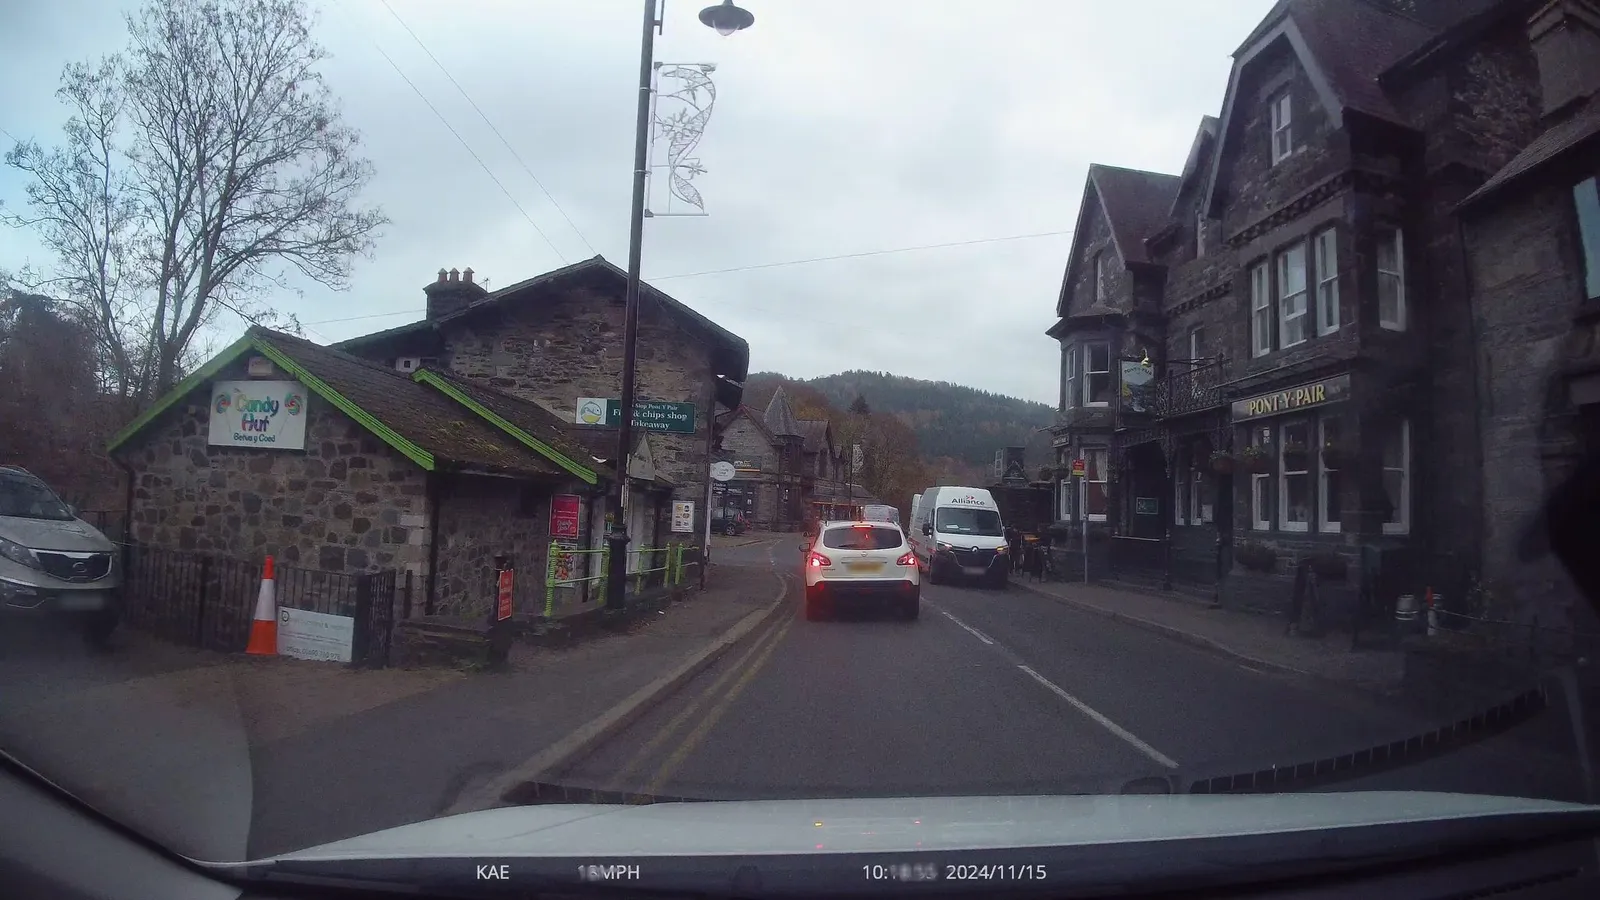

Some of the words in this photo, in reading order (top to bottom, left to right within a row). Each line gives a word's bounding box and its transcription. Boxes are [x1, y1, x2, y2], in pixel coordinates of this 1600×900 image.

[235, 393, 279, 417] Candy
[633, 410, 640, 418] &
[642, 410, 665, 420] chips
[667, 411, 688, 421] shop
[241, 413, 269, 432] Hut
[631, 419, 670, 430] Takeaway
[258, 433, 276, 443] Coed
